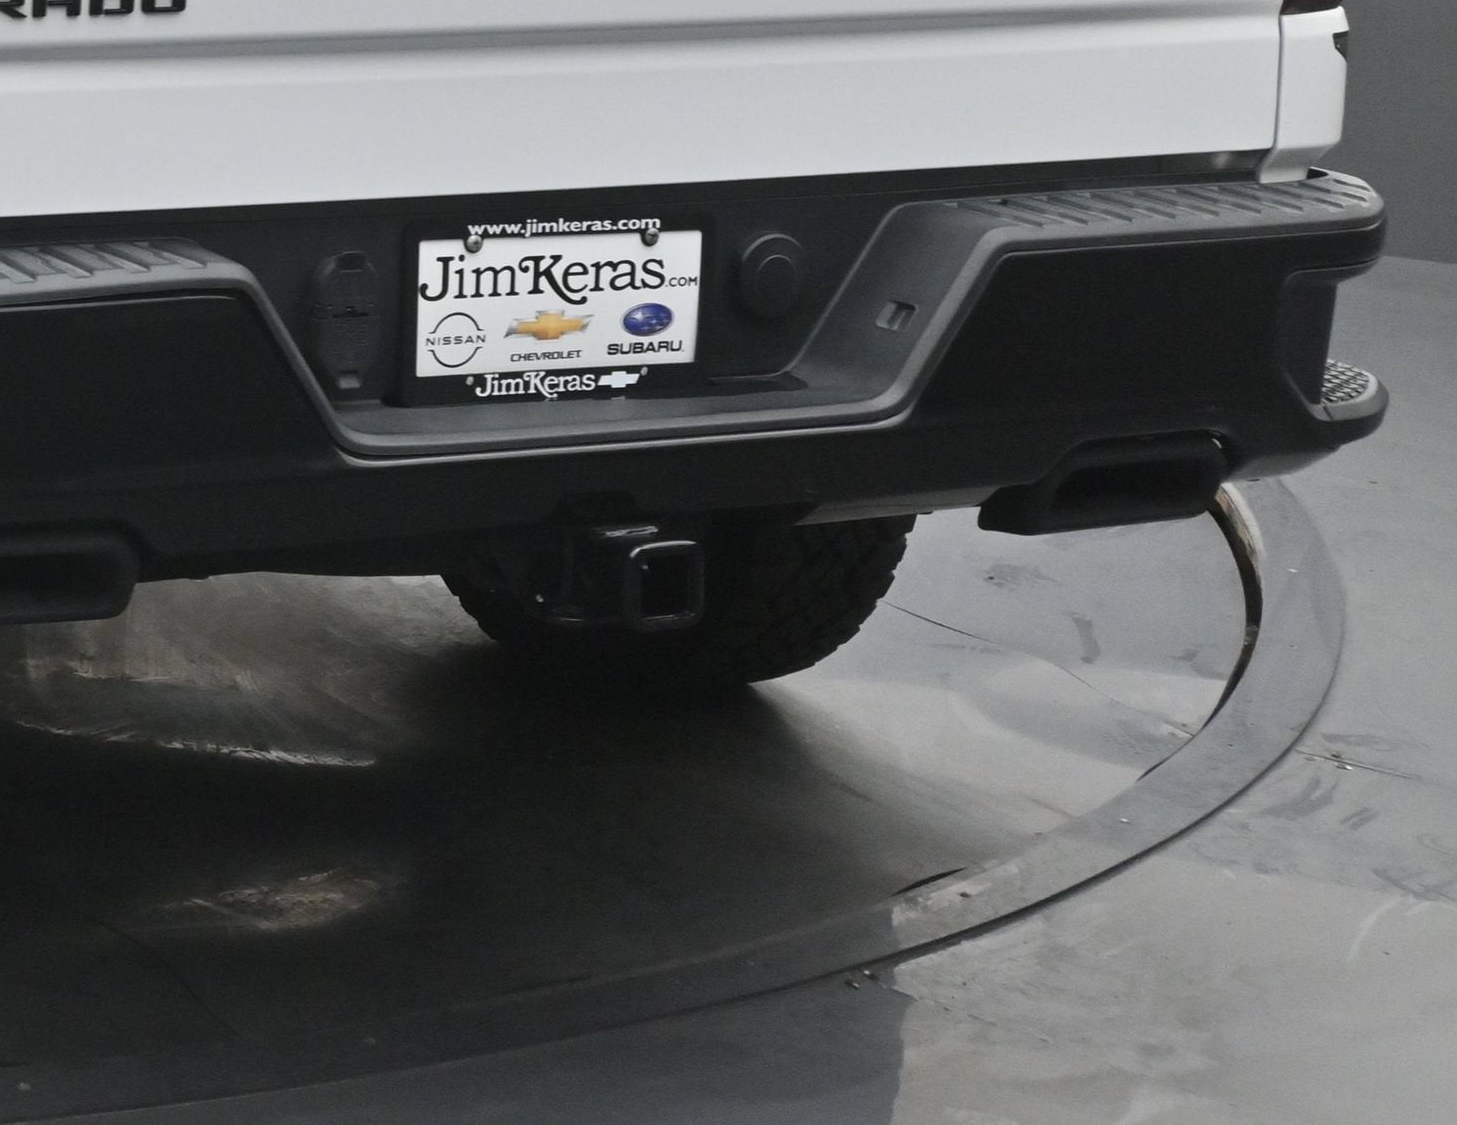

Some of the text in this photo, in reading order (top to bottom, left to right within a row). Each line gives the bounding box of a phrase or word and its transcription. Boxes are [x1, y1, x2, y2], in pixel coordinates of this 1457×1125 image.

[468, 218, 661, 237] www.jimkeras.com
[425, 334, 486, 347] NISSAN
[607, 340, 683, 355] SUBARU
[510, 350, 583, 362] CHEVROLET
